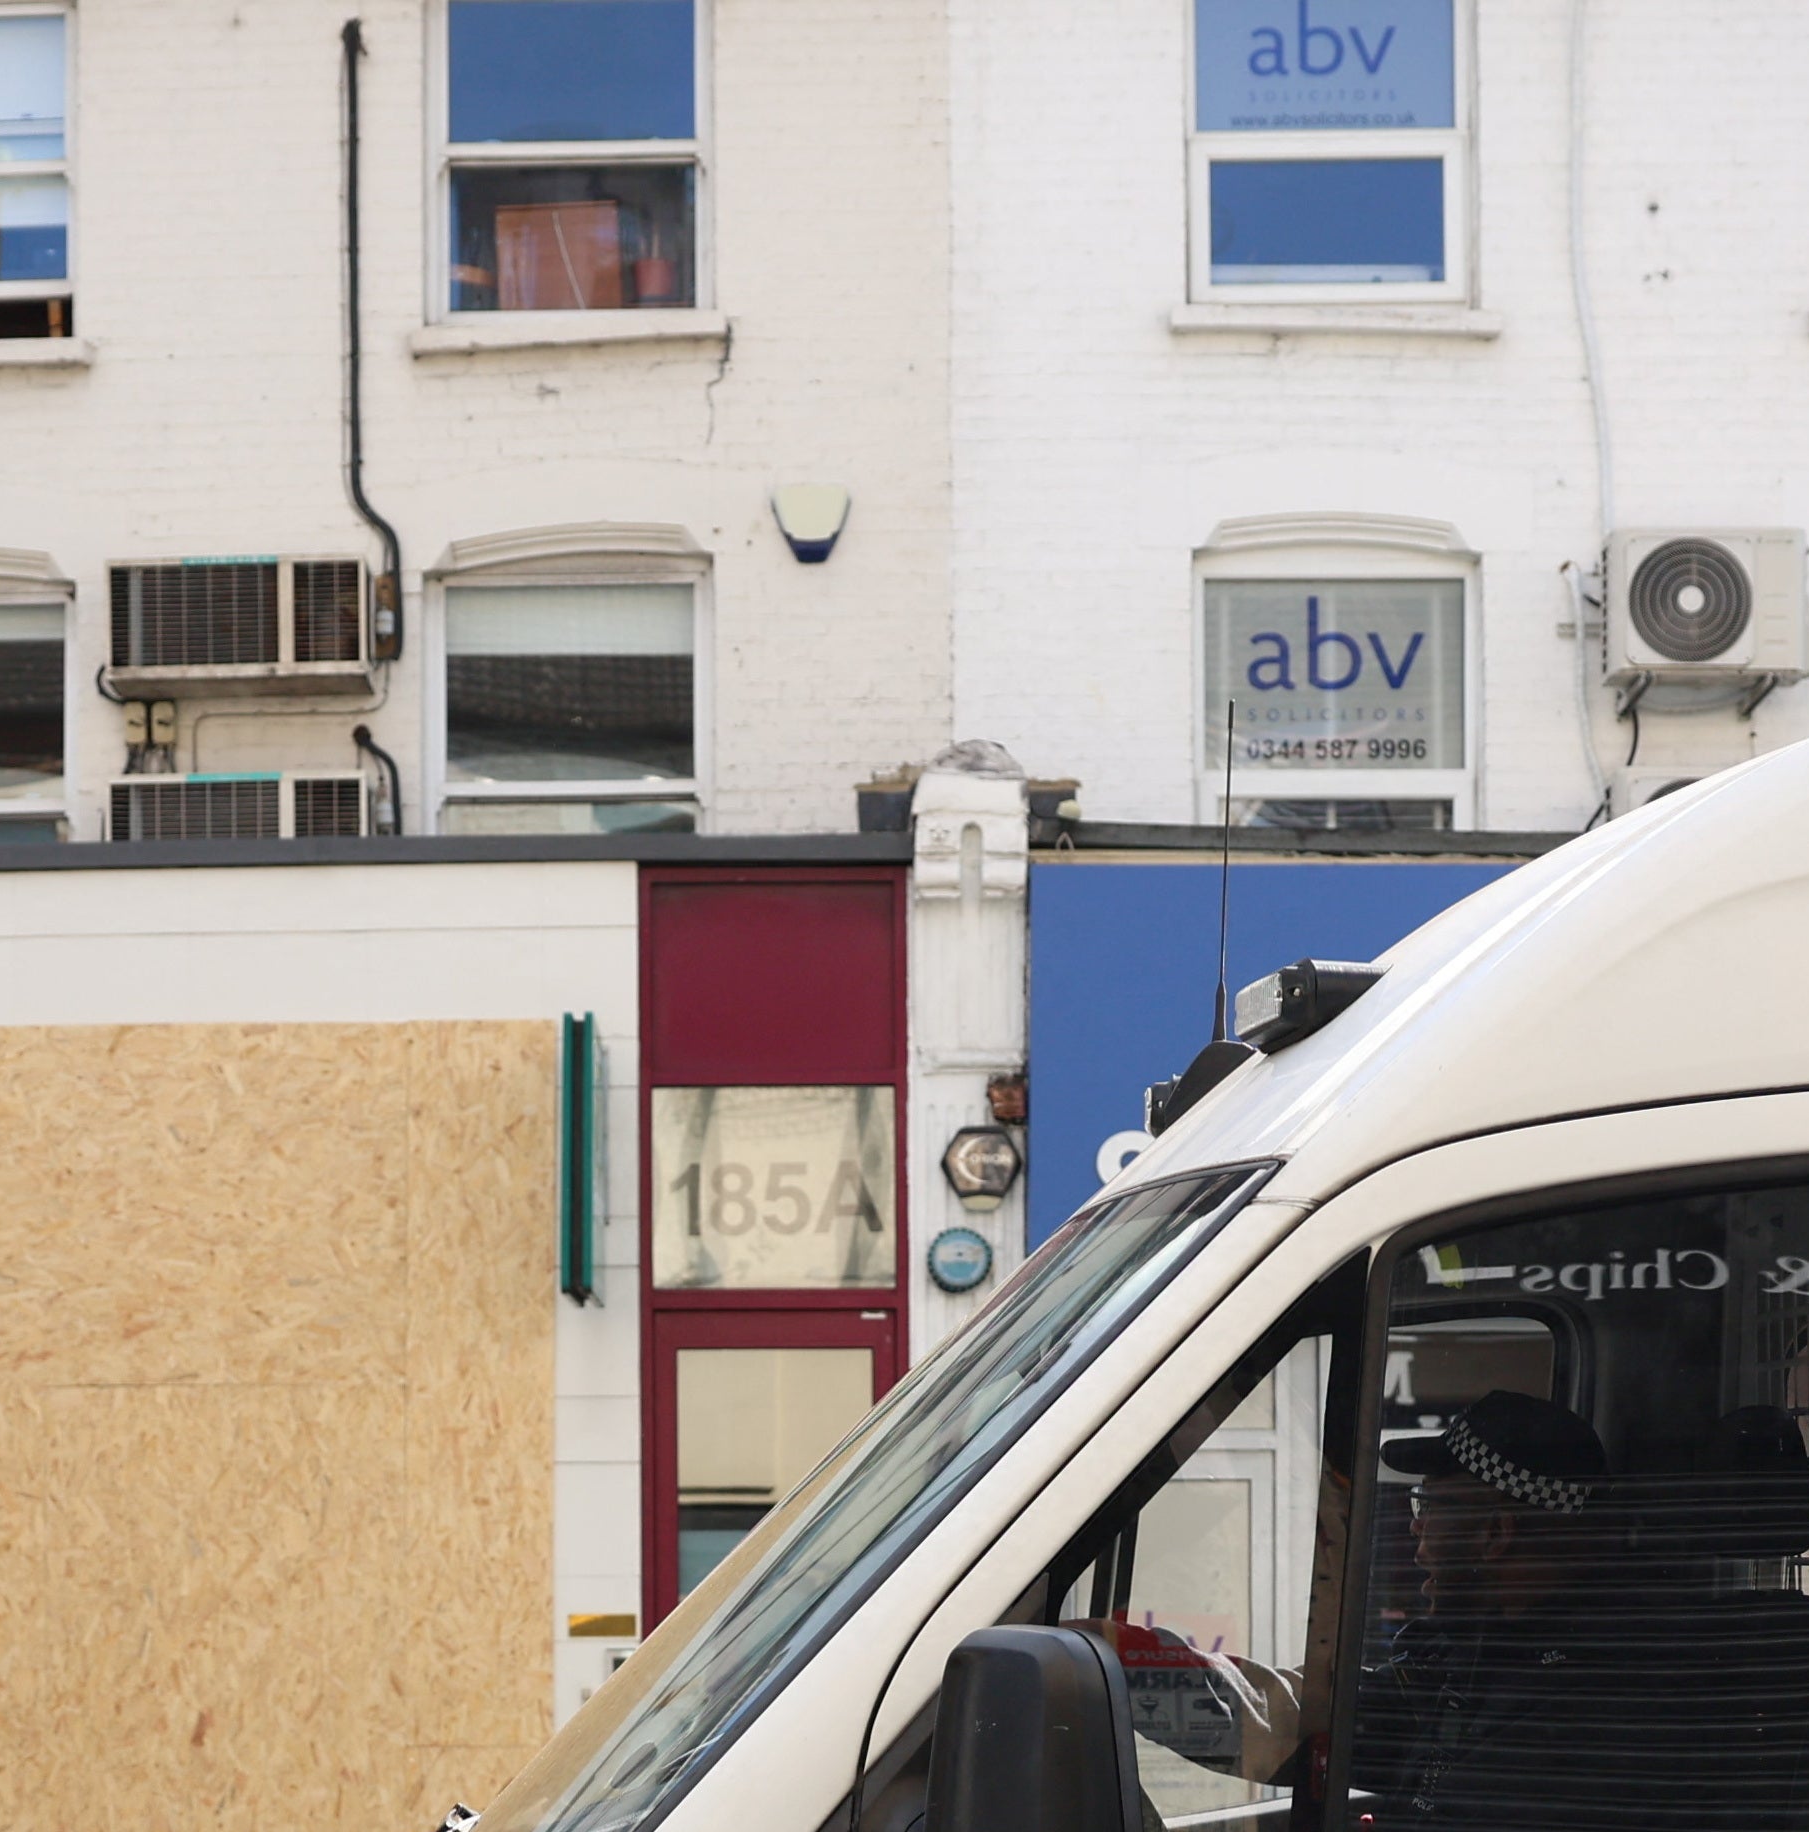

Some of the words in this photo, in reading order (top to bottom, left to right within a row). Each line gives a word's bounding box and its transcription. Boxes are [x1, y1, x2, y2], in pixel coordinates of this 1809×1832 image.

[1247, 0, 1397, 77] abv
[1248, 89, 1397, 103] SOLICITORS
[1247, 596, 1425, 691] abv
[1247, 707, 1426, 722] SOLICITORS
[1247, 738, 1307, 761] 0344
[1315, 738, 1360, 760] 587
[1367, 738, 1427, 760] 9996
[670, 1160, 885, 1238] 185A
